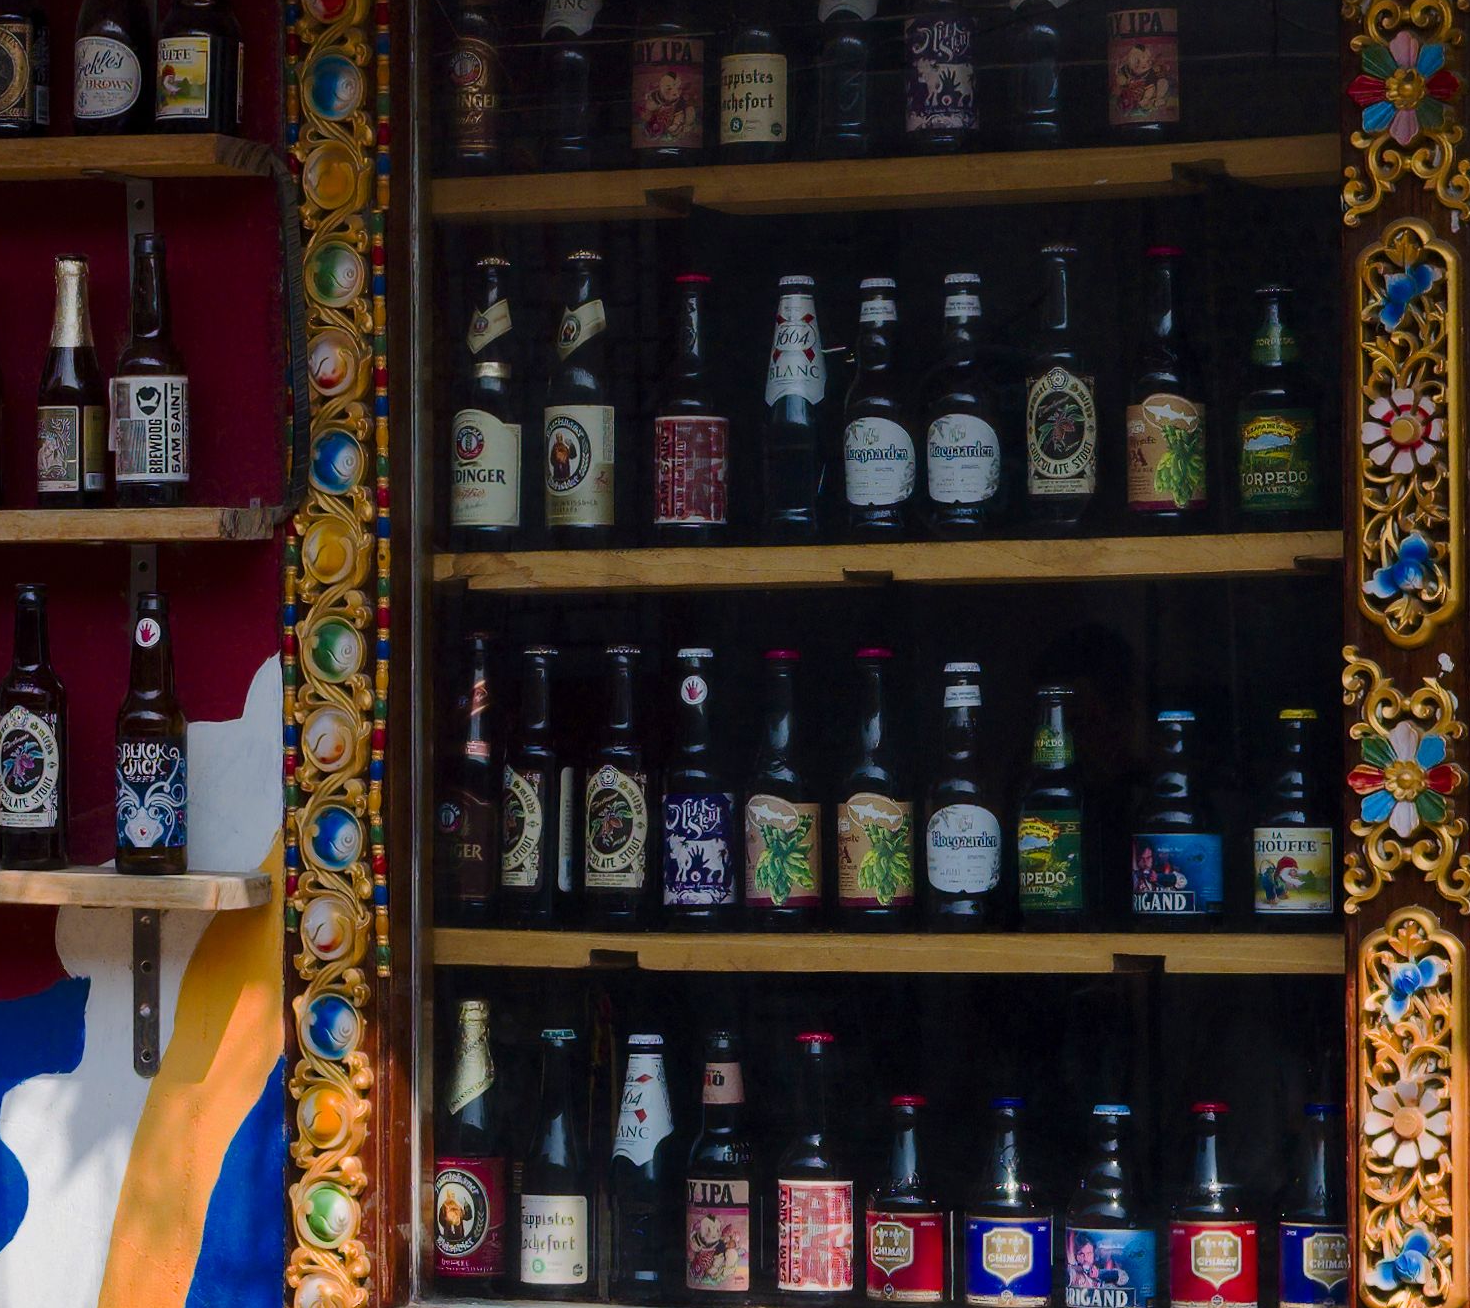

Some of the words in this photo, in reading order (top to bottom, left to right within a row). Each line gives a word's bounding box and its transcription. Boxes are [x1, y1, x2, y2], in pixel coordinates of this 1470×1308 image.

[775, 330, 810, 347] 1664
[769, 364, 820, 381] BLANC
[171, 385, 181, 433] SAINT
[149, 419, 163, 474] BREWDOG
[171, 437, 181, 473] 5AM
[453, 468, 507, 486] DINGER
[1241, 469, 1308, 487] TORPEDO
[121, 743, 171, 761] BLACK
[701, 1183, 735, 1204] IPA
[872, 1246, 909, 1258] CHIMAY
[987, 1253, 1027, 1264] CHIMAY
